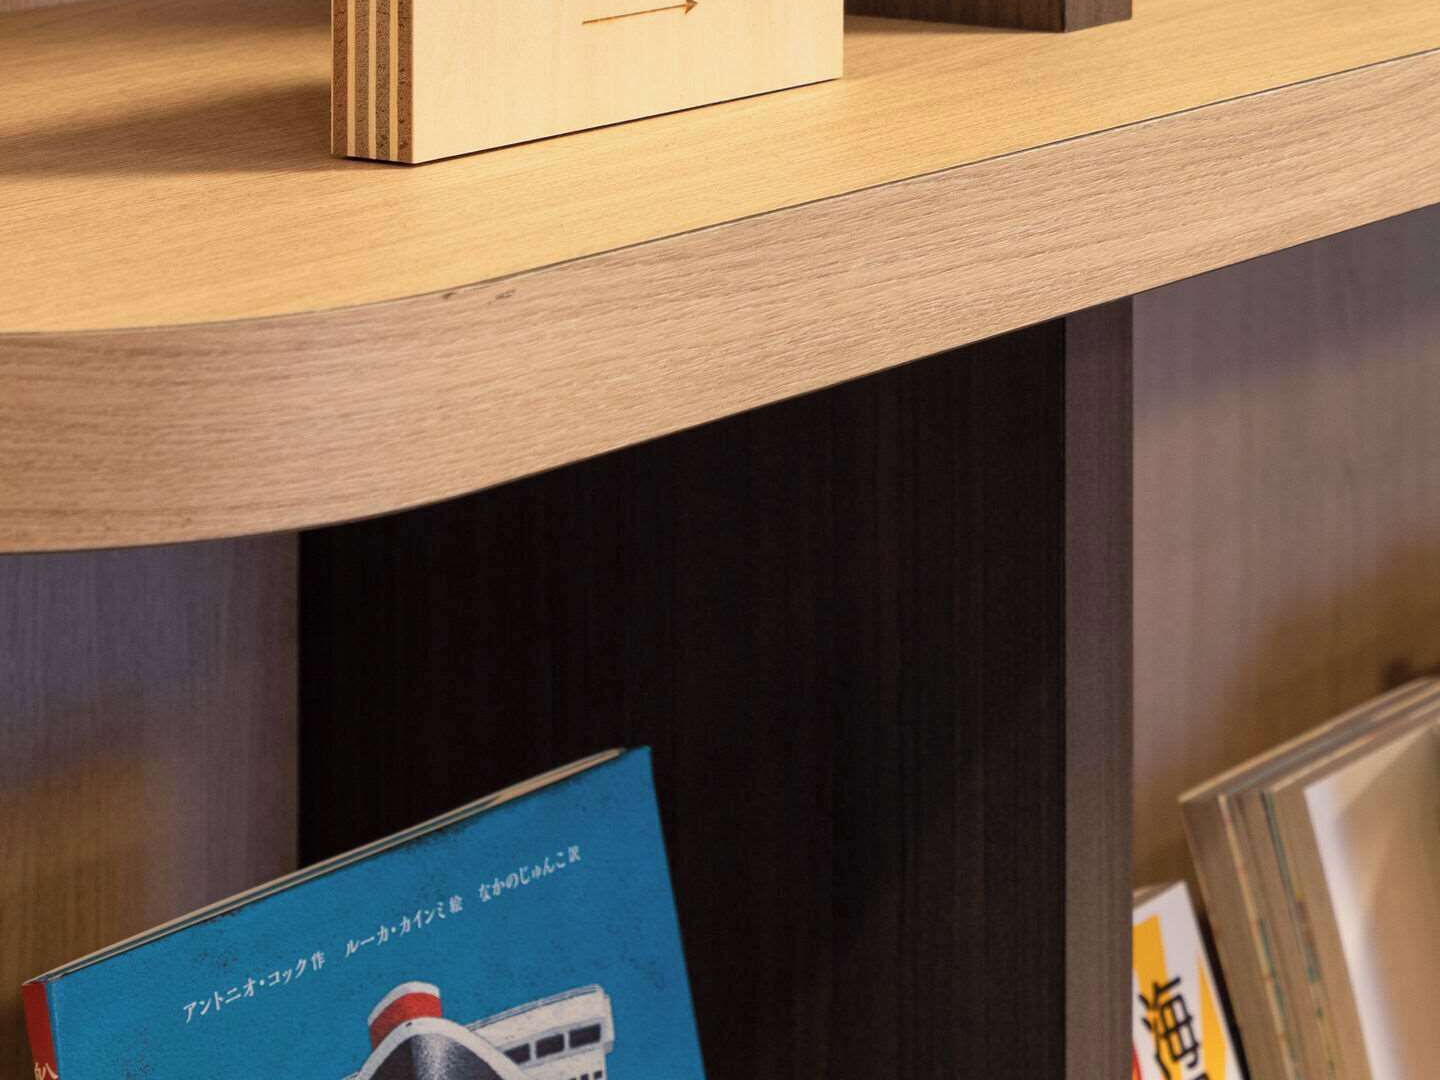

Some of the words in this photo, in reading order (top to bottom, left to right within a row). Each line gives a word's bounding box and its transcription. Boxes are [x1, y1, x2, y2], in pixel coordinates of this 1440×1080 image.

[183, 951, 327, 1024] アントニオ・コック作
[343, 894, 464, 958] ルーカ・カインミ絵
[478, 845, 582, 903] なかのじゅんこ訳
